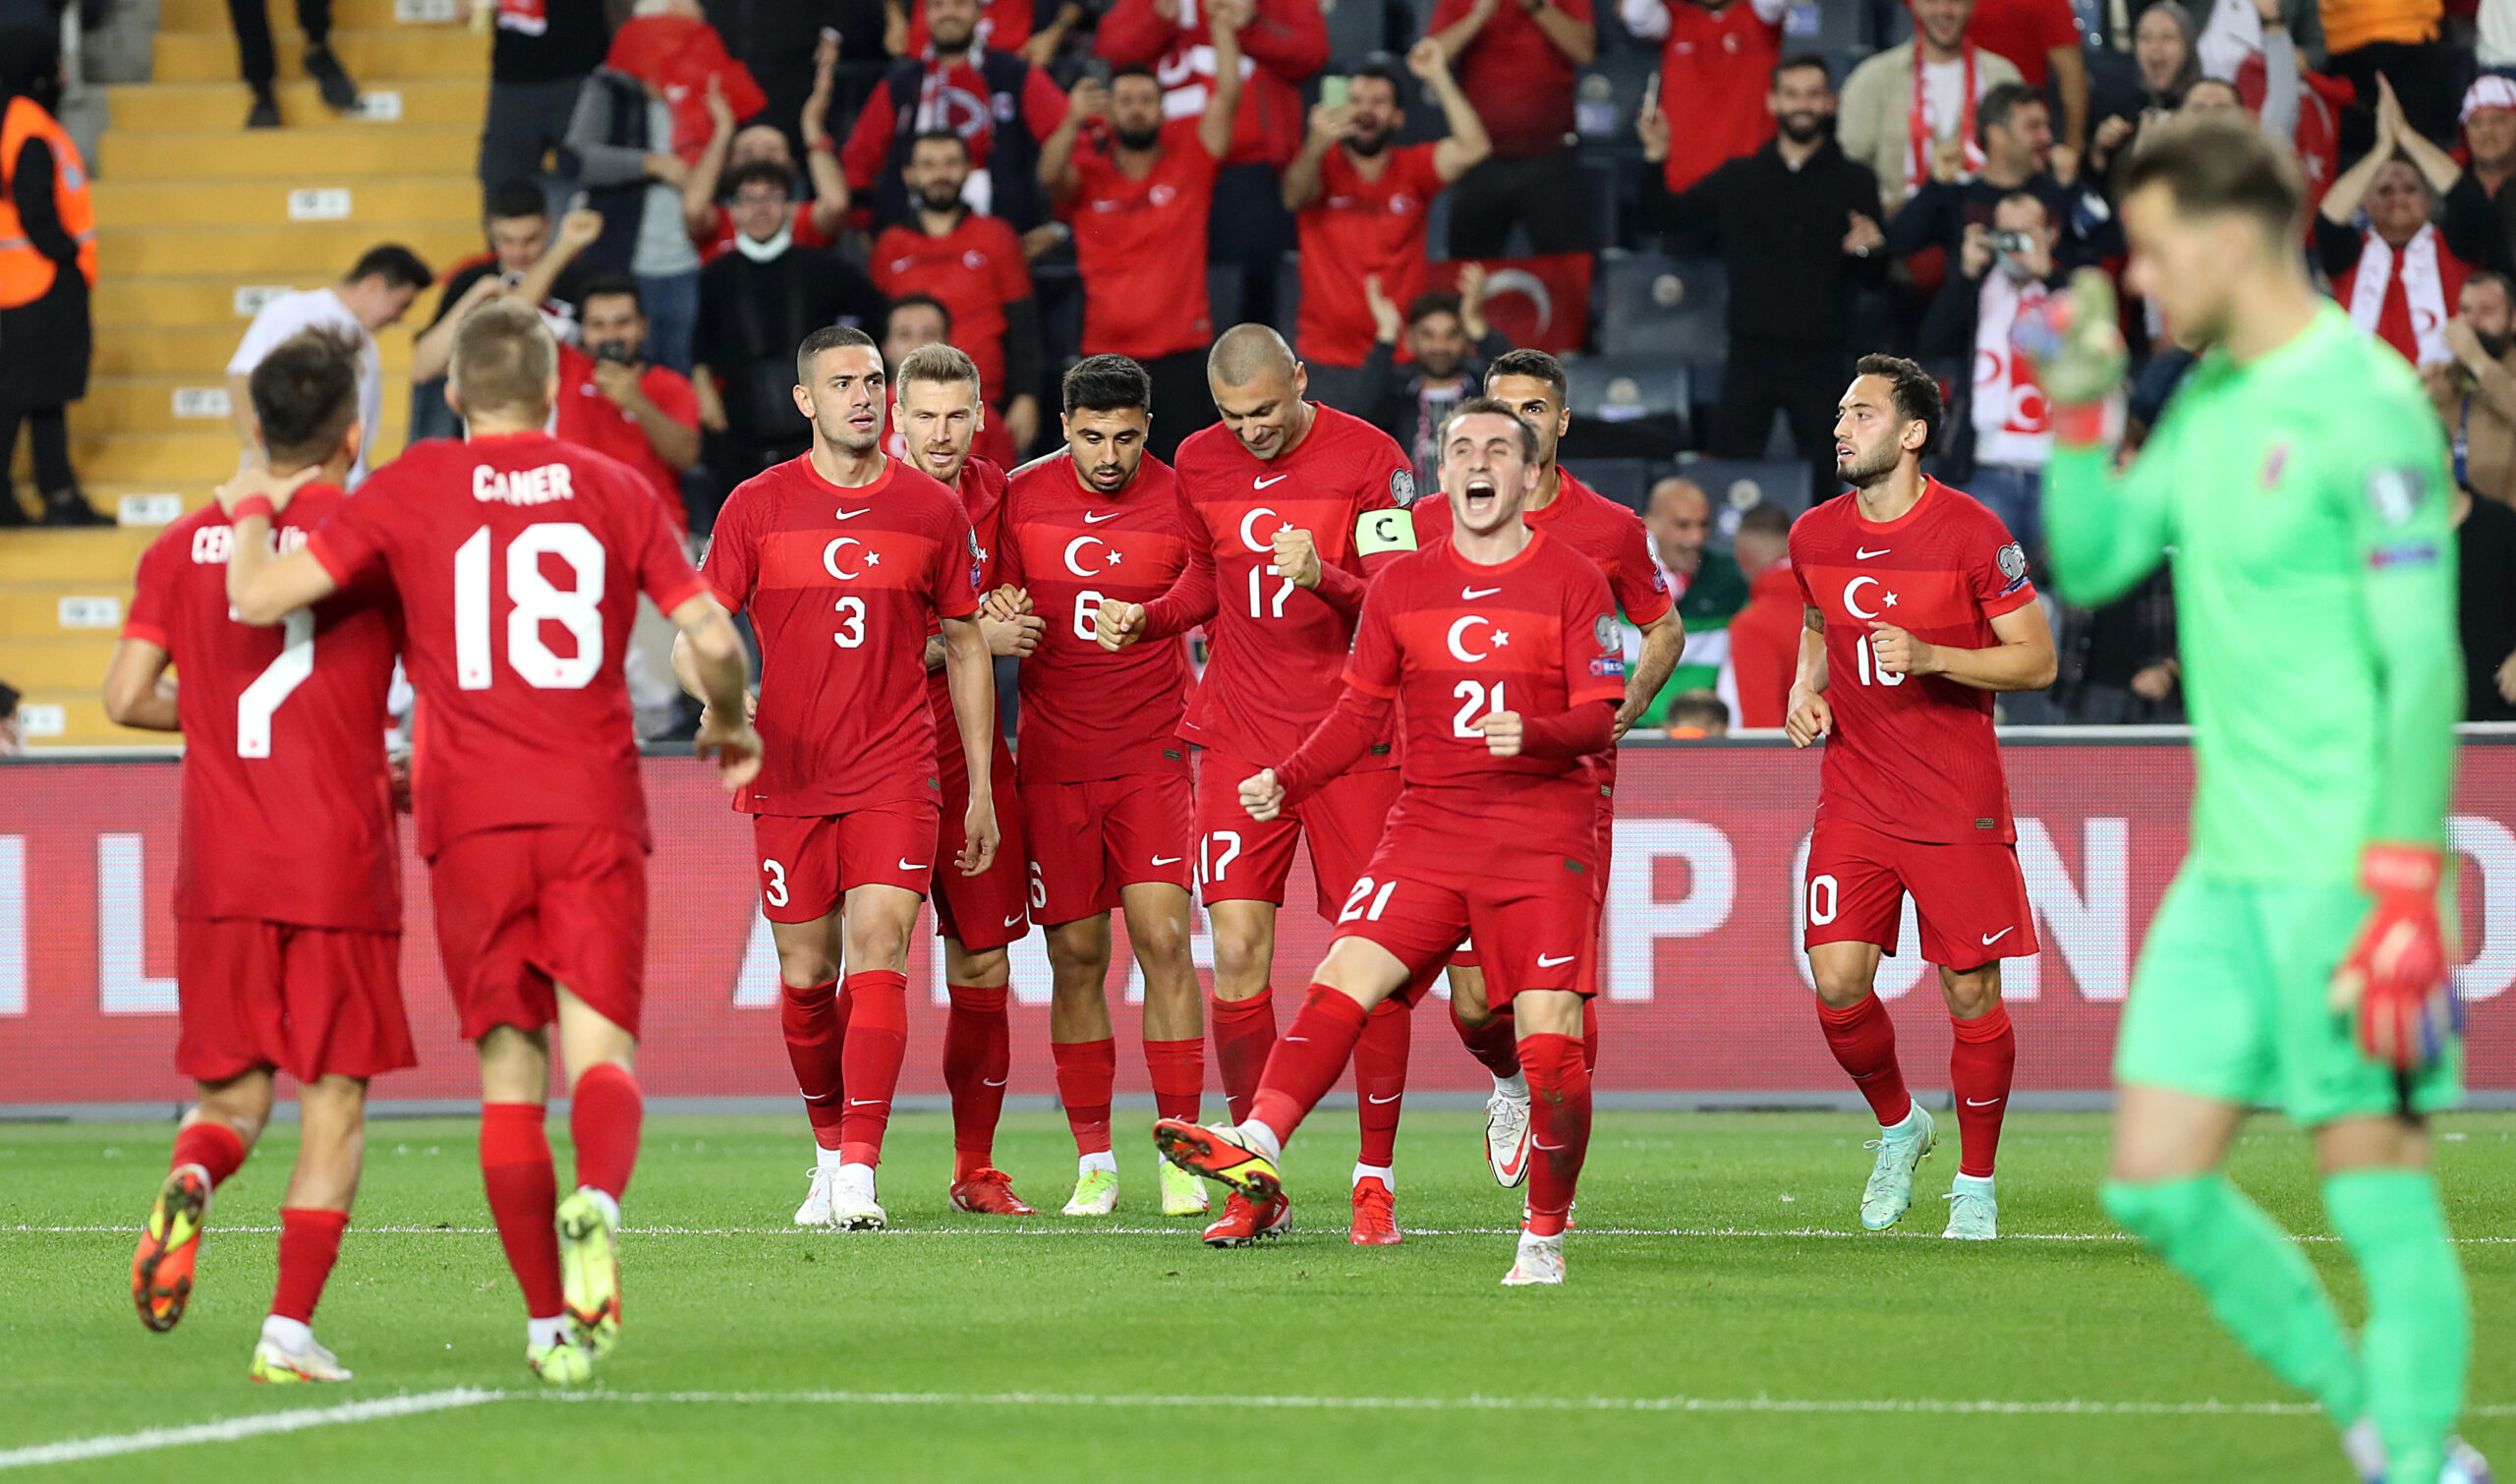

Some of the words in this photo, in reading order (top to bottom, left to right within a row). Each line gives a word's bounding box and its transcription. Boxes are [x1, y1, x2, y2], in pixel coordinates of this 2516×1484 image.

[473, 463, 574, 506] CANER
[1376, 517, 1399, 542] C
[455, 523, 605, 690] 18
[1074, 590, 1105, 641] 6
[1249, 564, 1294, 618] 17
[833, 596, 866, 649] 3
[1454, 680, 1505, 737] 21
[763, 858, 789, 907] 3
[1200, 830, 1241, 885] 17
[1337, 876, 1397, 926] 21
